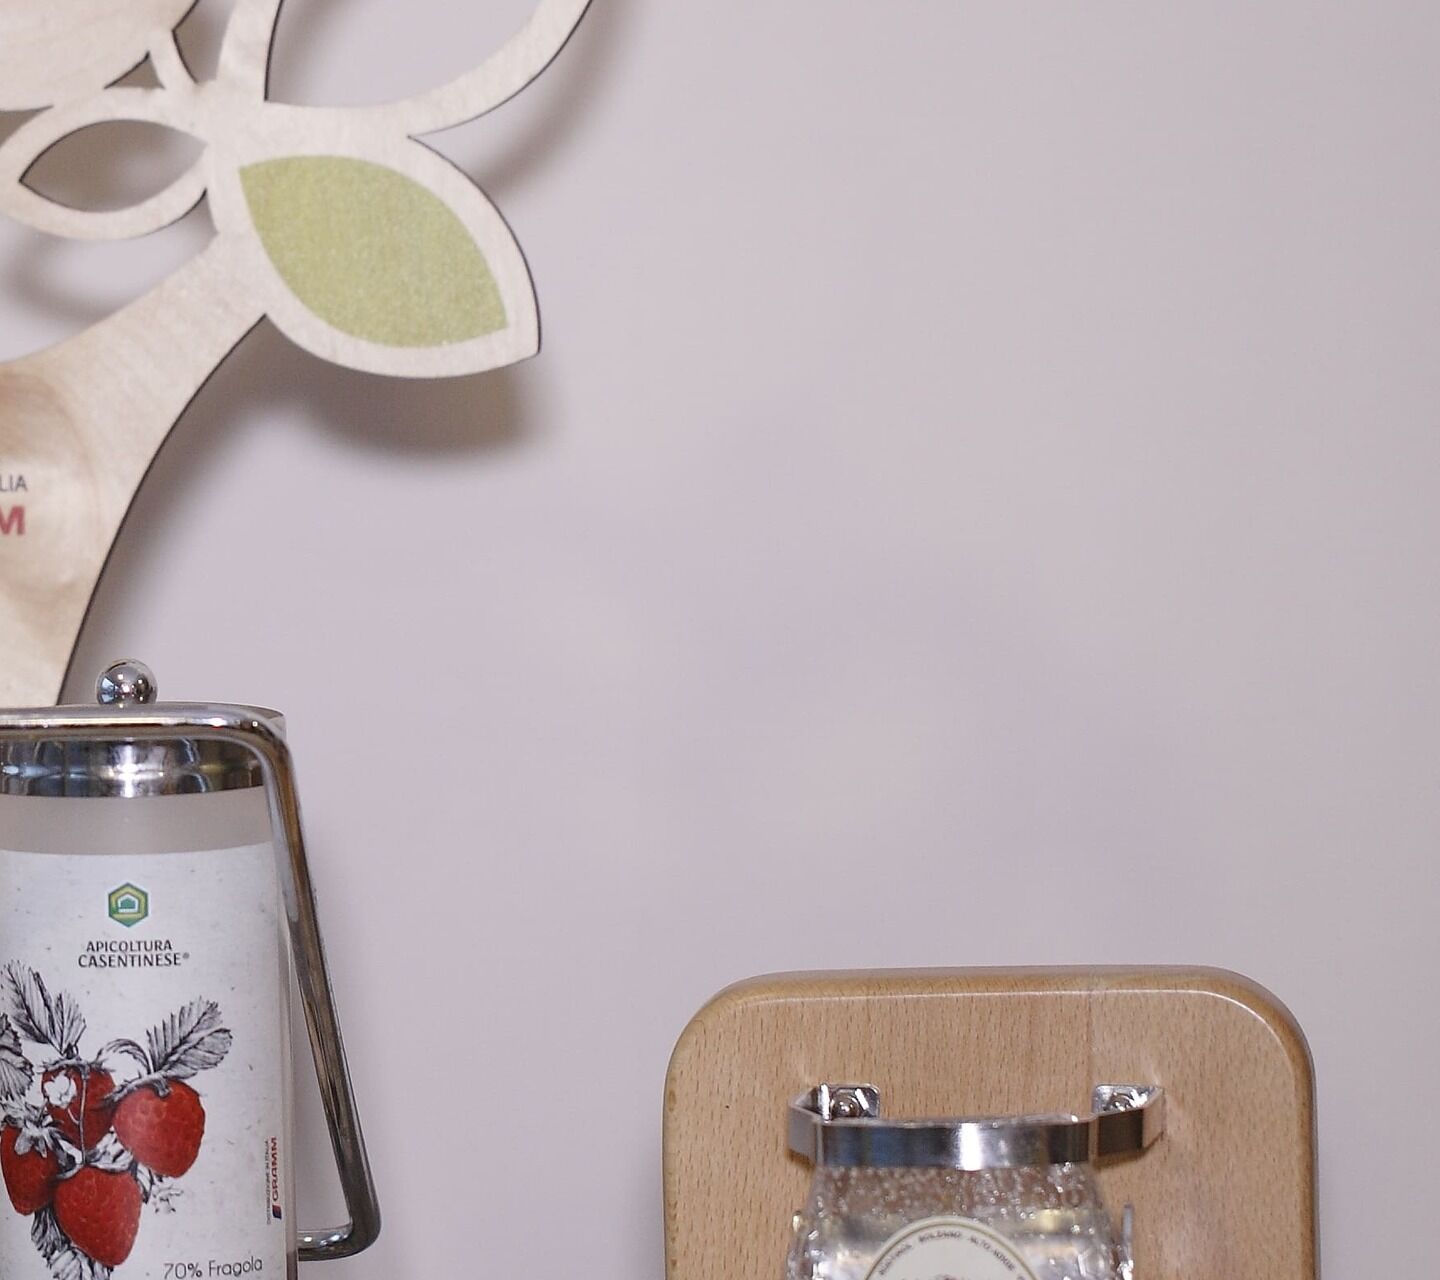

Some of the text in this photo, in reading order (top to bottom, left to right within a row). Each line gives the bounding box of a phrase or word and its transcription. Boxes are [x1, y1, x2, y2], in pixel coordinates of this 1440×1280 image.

[86, 939, 173, 953] APICOLTURA
[78, 953, 181, 968] CASENTINESE
[163, 1256, 263, 1280] 70% Fragola
